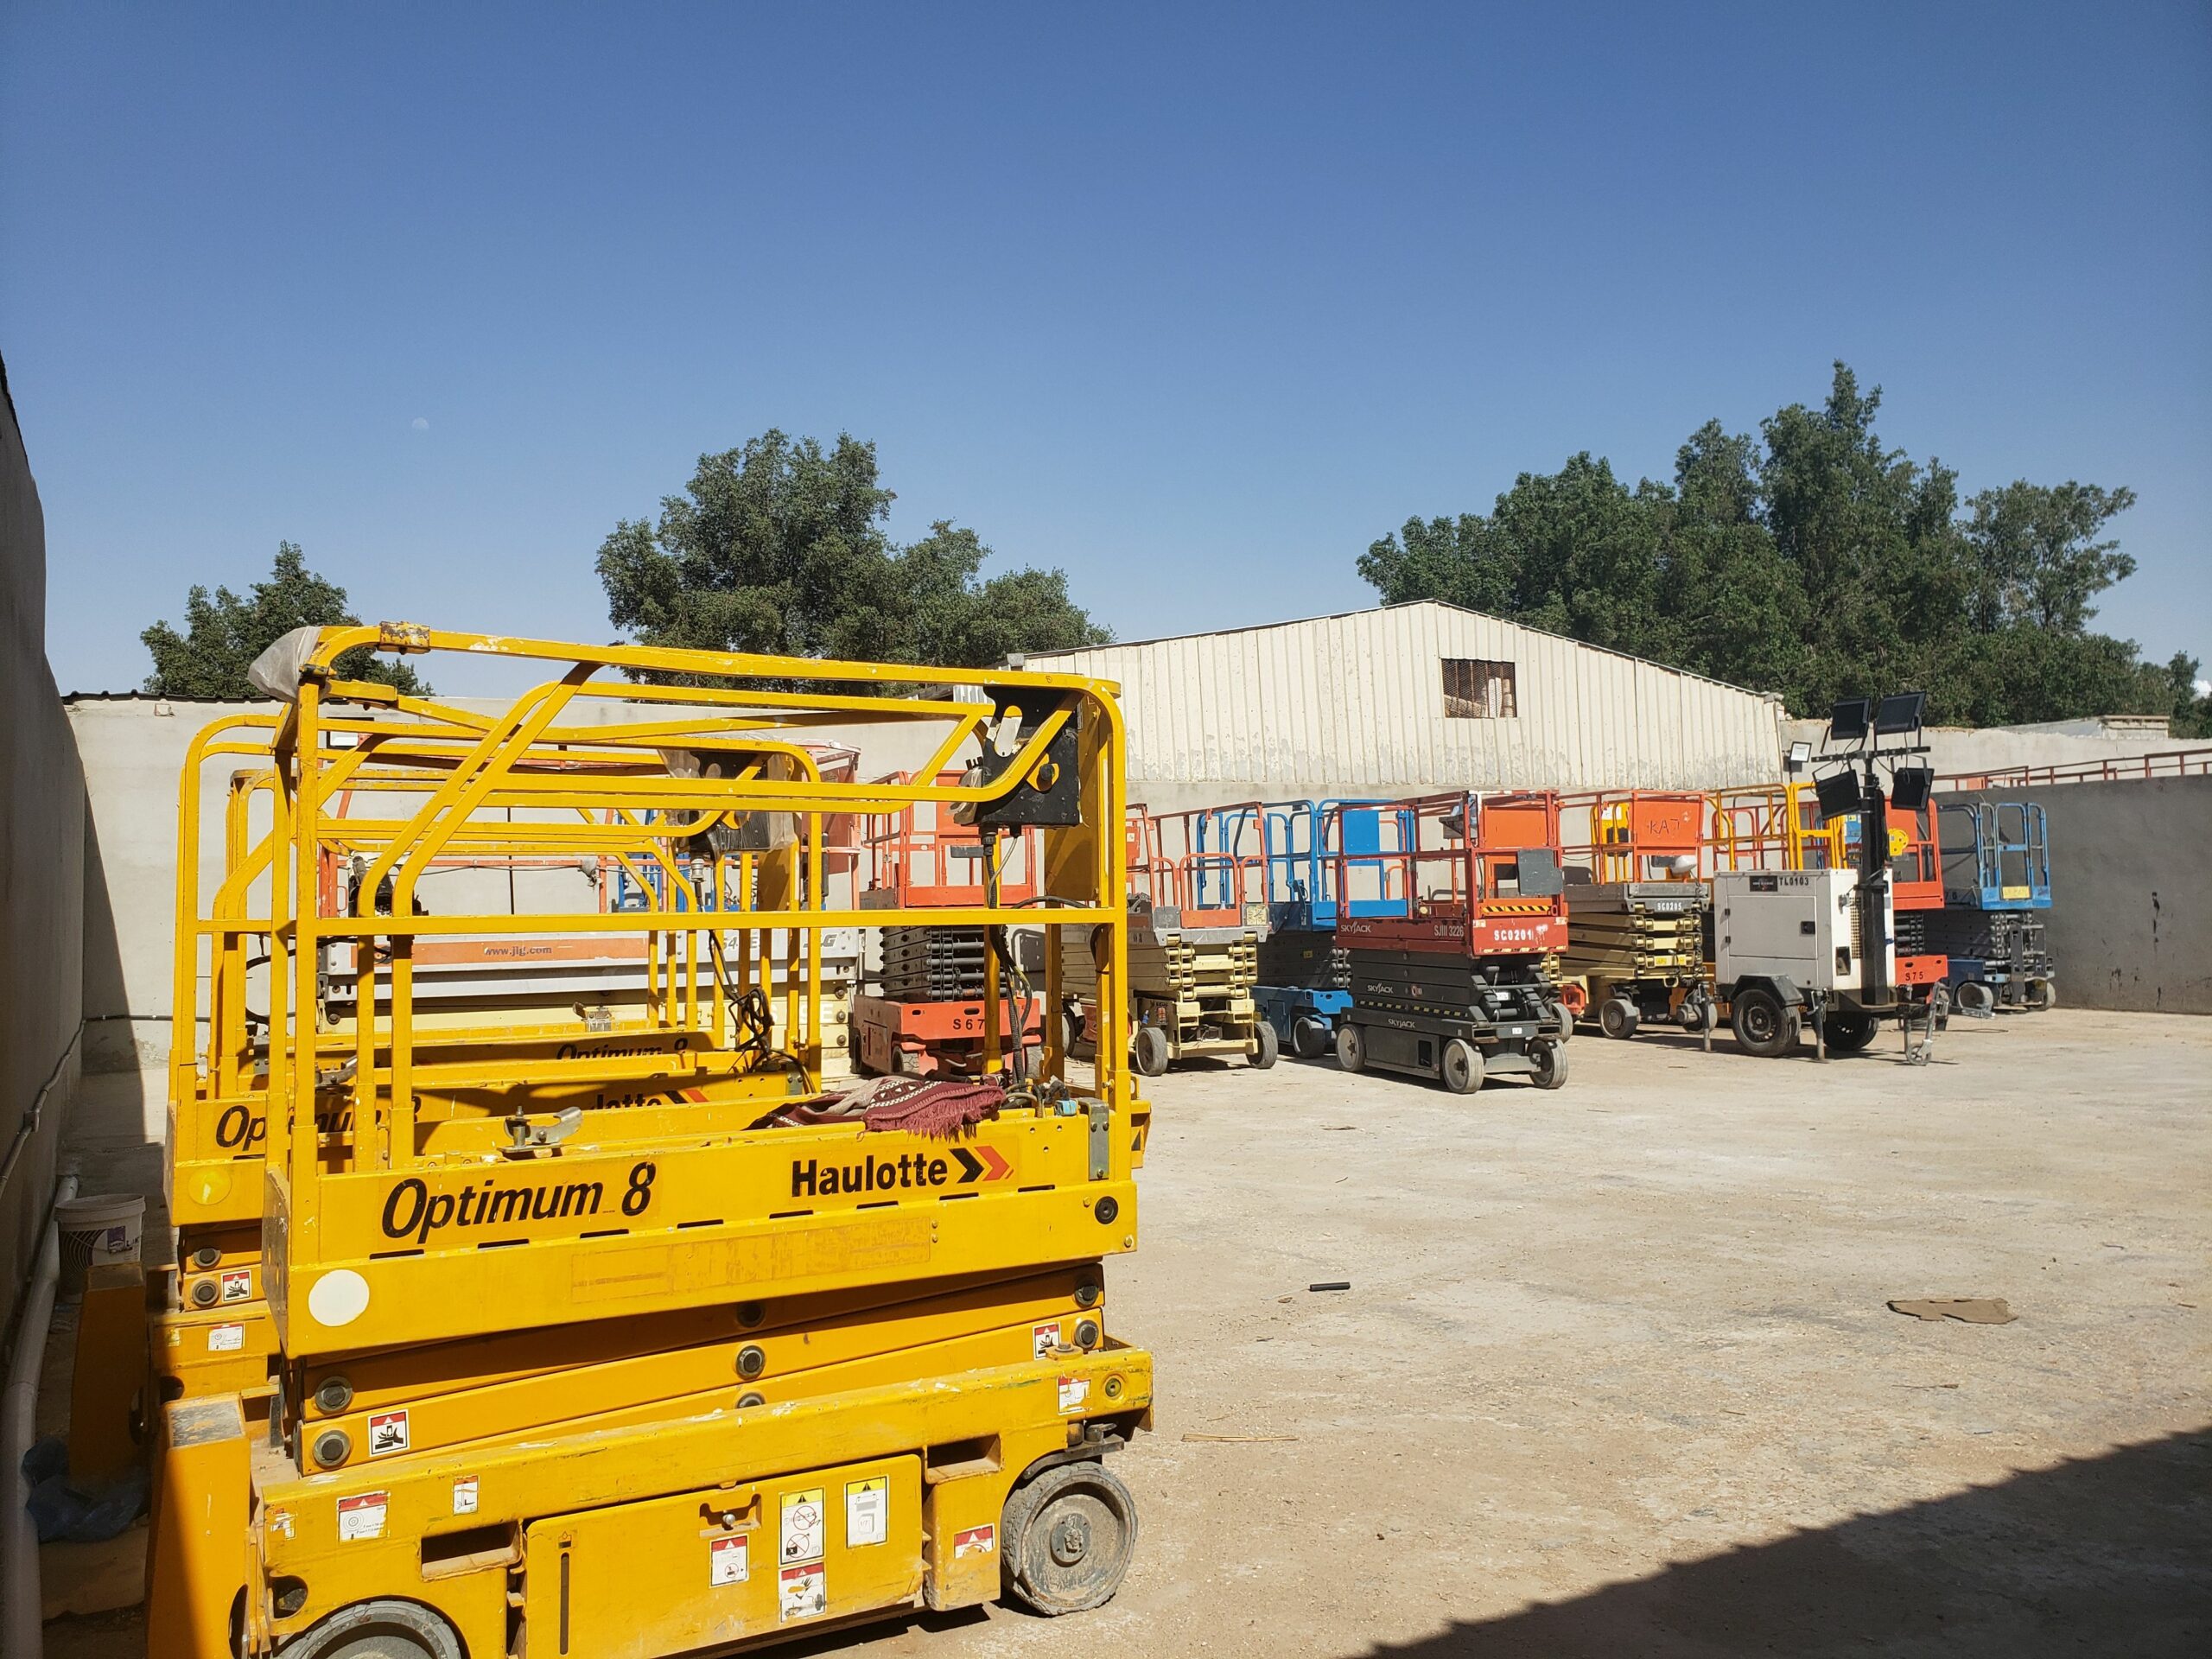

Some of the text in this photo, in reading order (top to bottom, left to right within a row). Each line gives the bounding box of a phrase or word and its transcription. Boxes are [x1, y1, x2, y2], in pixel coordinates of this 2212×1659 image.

[1779, 876, 1809, 887] TL0103
[1340, 921, 1372, 934] SKYJACK
[1448, 925, 1465, 938] 3226
[1493, 929, 1533, 941] SC0201
[485, 945, 552, 957] www.jlg.com
[1367, 982, 1394, 995] SKYJACK
[1388, 1018, 1415, 1029] SKYJACK
[791, 1153, 948, 1198] Haulotte
[382, 1161, 657, 1244] Optimum 8
